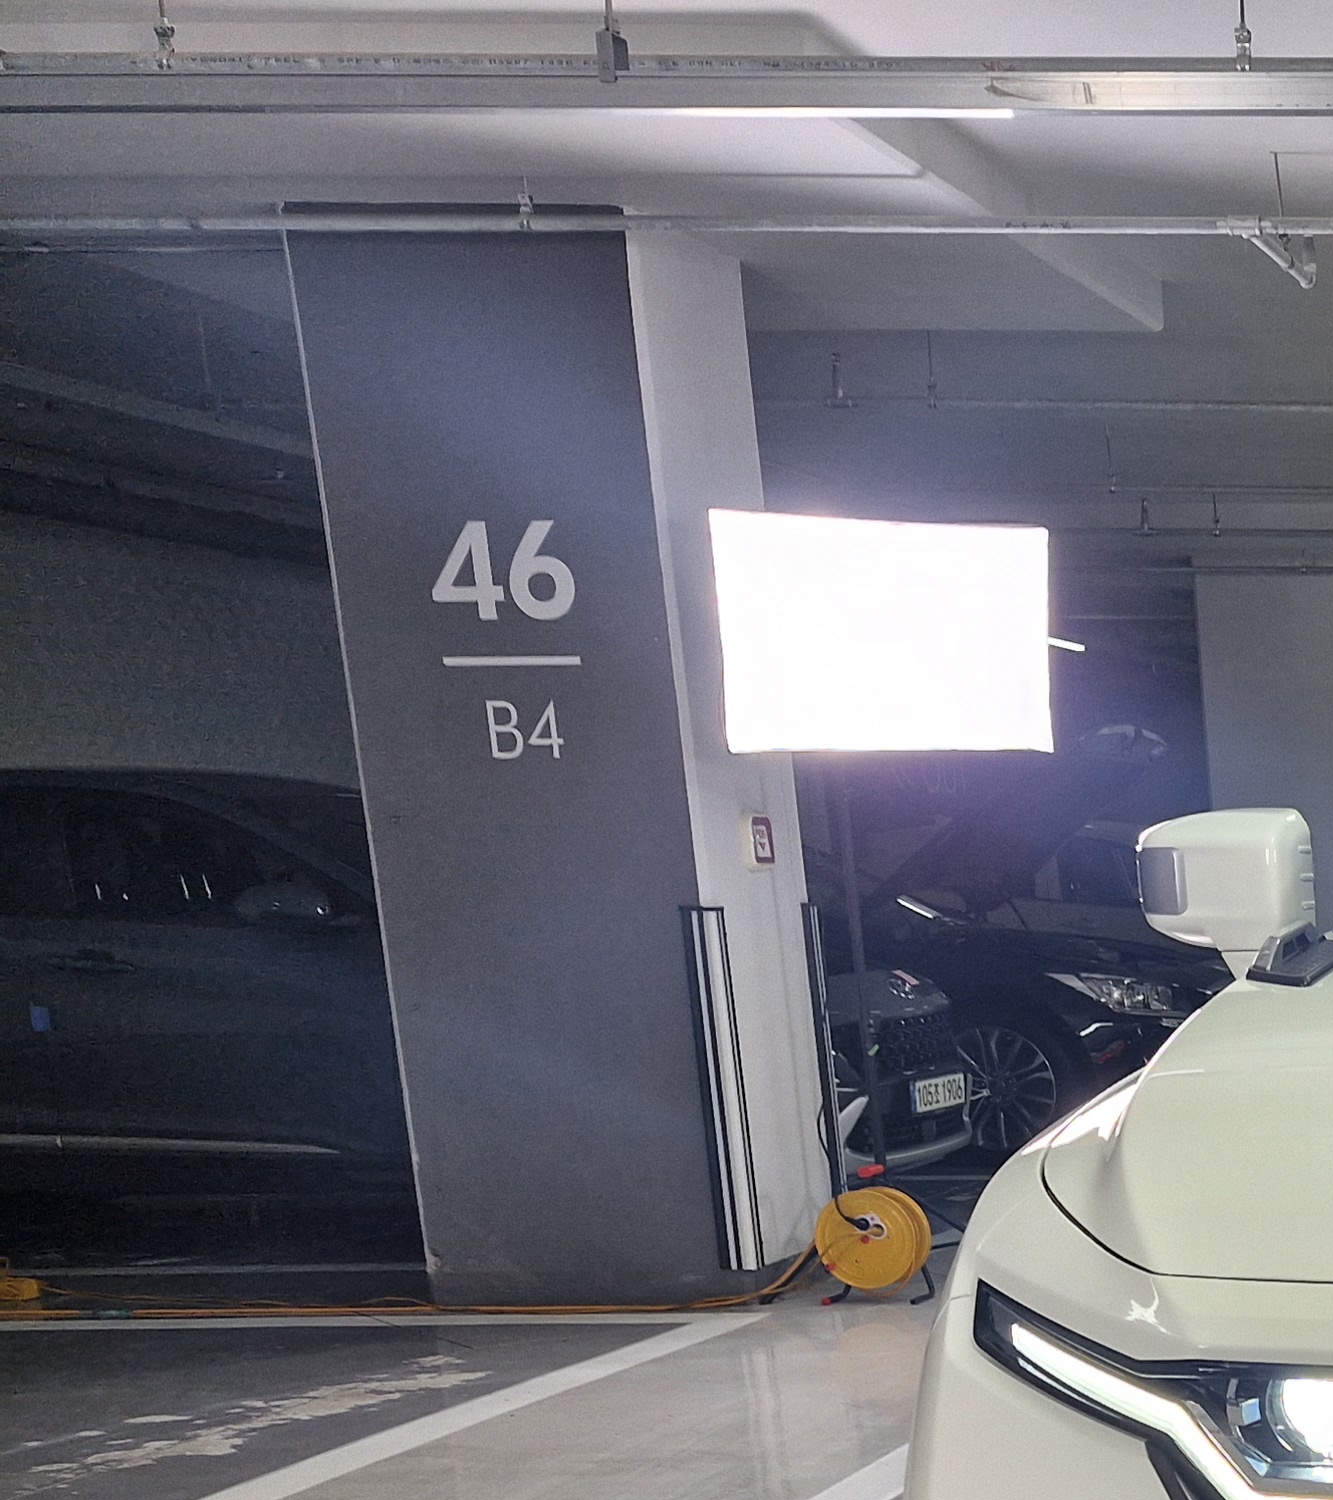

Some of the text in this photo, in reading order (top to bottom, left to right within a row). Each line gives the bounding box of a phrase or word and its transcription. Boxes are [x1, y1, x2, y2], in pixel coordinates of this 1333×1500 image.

[431, 519, 576, 621] 46
[485, 699, 565, 760] B4
[942, 1077, 963, 1102] 1906
